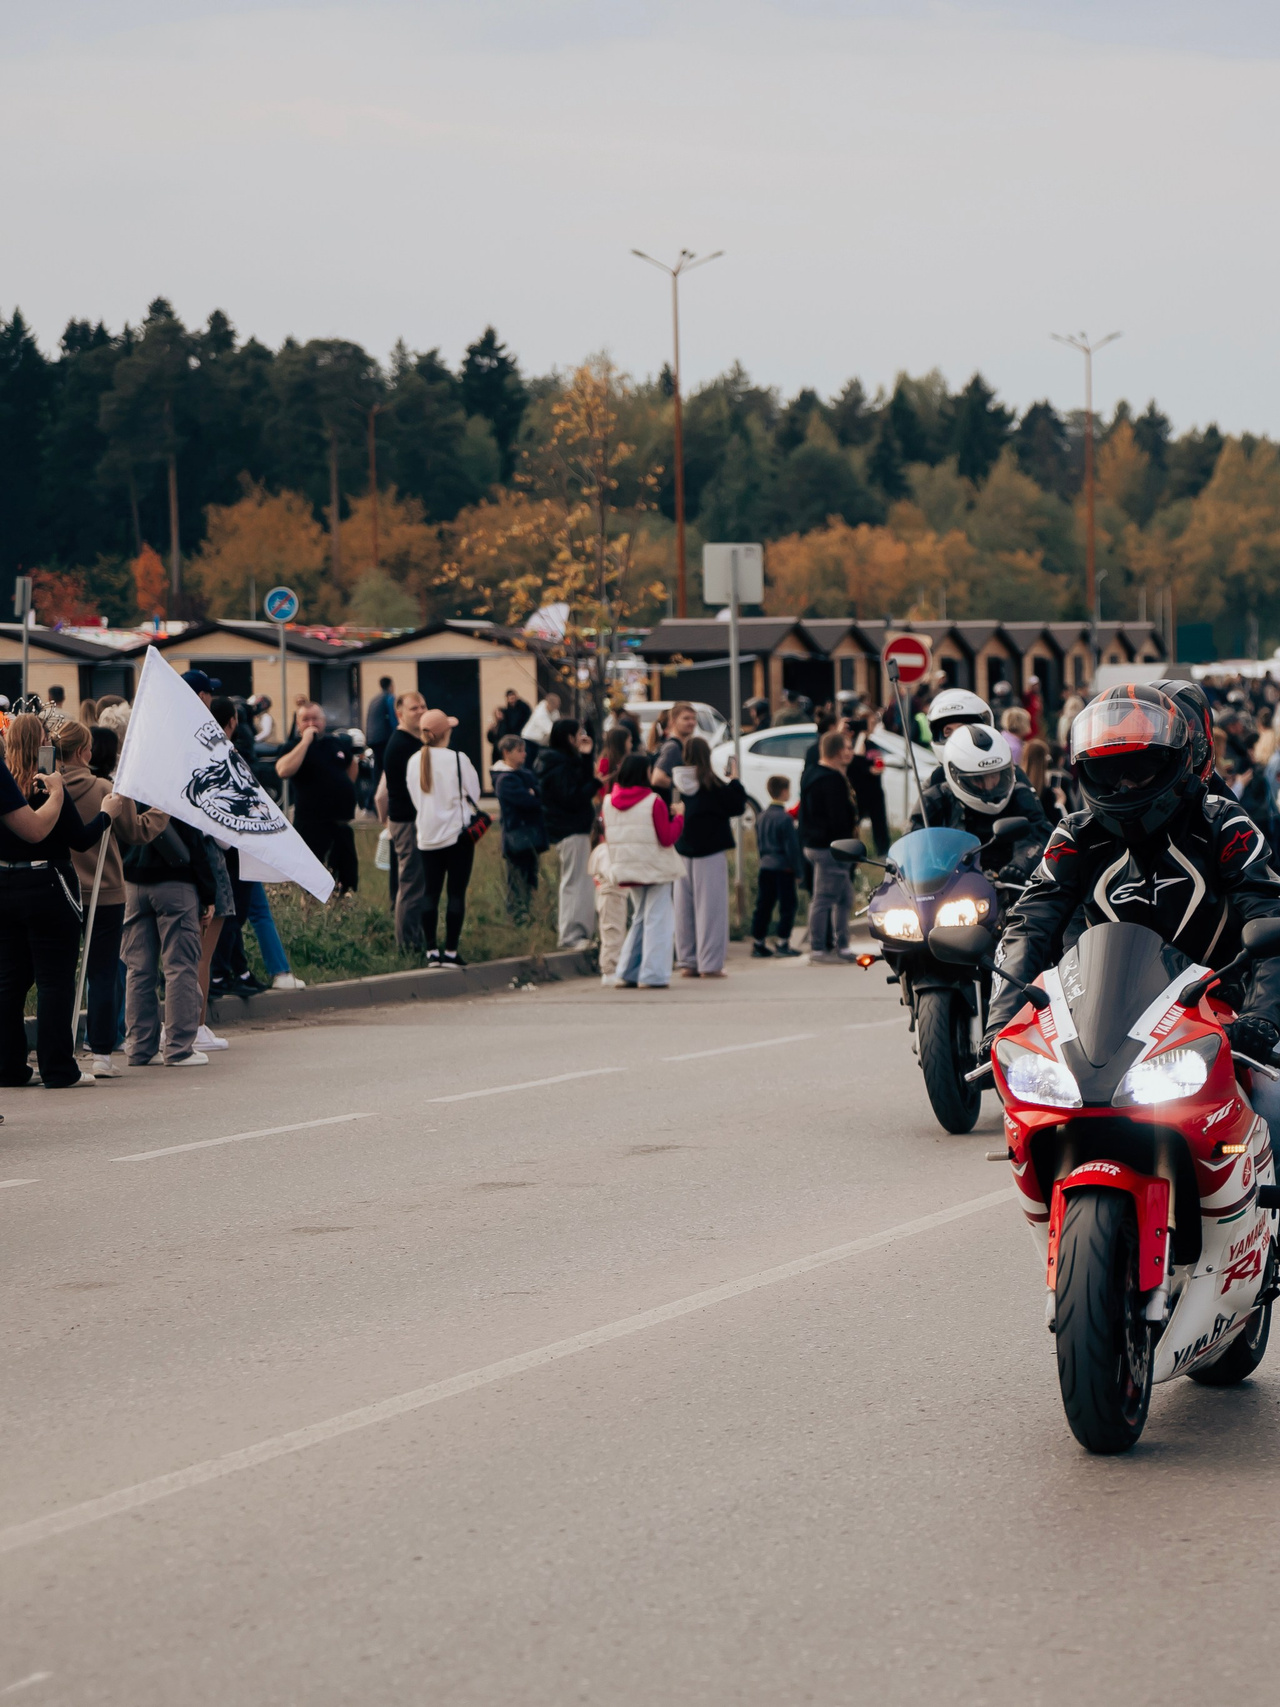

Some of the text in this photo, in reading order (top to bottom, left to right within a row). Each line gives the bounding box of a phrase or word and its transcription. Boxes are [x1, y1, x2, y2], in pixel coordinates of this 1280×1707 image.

[1037, 1003, 1058, 1040] YAMAHA
[1152, 1003, 1188, 1036] YAMAHA
[1070, 1164, 1117, 1177] YAMAHA
[1228, 1209, 1267, 1262] YAMAHA
[1220, 1248, 1262, 1295] R1
[1171, 1311, 1238, 1374] YAMAHA
